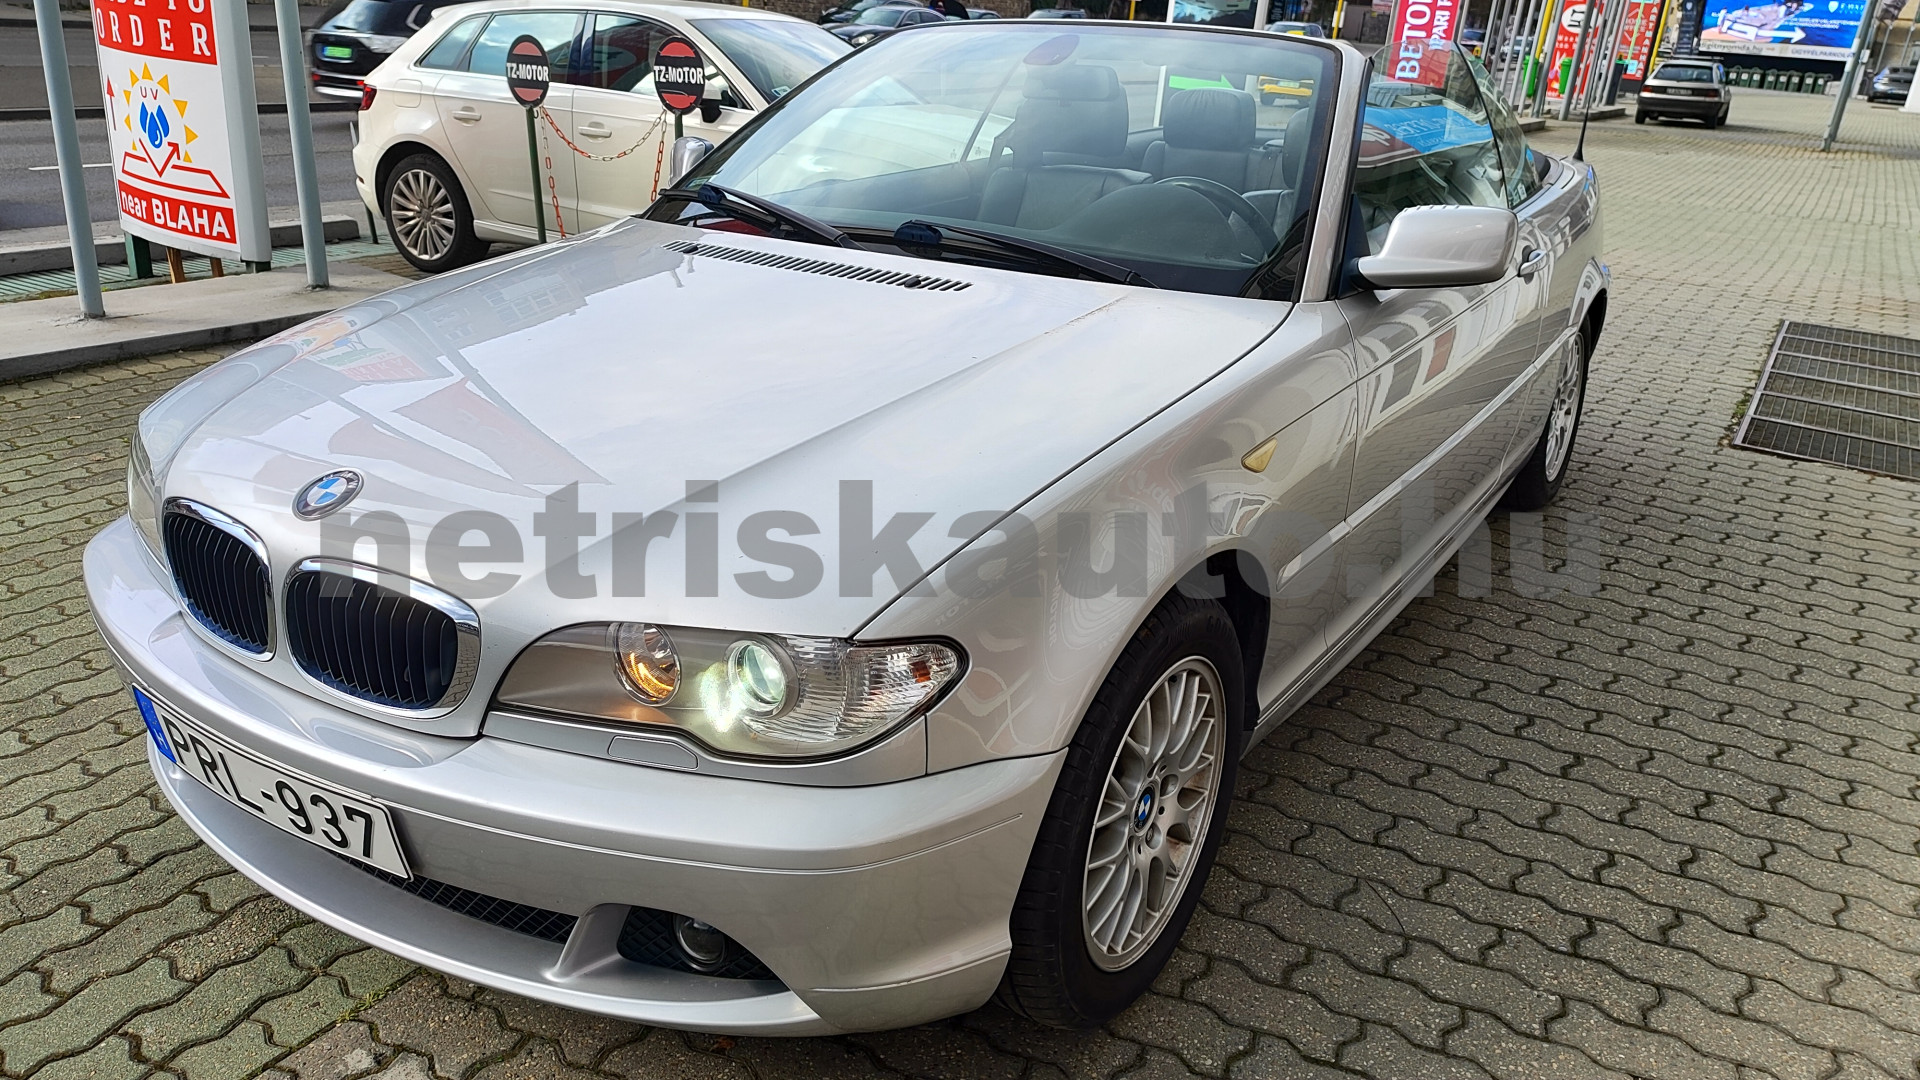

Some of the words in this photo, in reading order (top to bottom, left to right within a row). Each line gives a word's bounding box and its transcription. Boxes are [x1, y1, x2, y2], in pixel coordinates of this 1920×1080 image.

[95, 7, 211, 56] ORDER
[1394, 0, 1433, 80] BETO
[139, 86, 159, 101] UV
[506, 61, 549, 83] TZ-MOTOR
[653, 64, 705, 86] TZ-MOTOR
[120, 190, 147, 221] near
[152, 199, 231, 240] BLAHA
[161, 712, 374, 859] PRL-937
